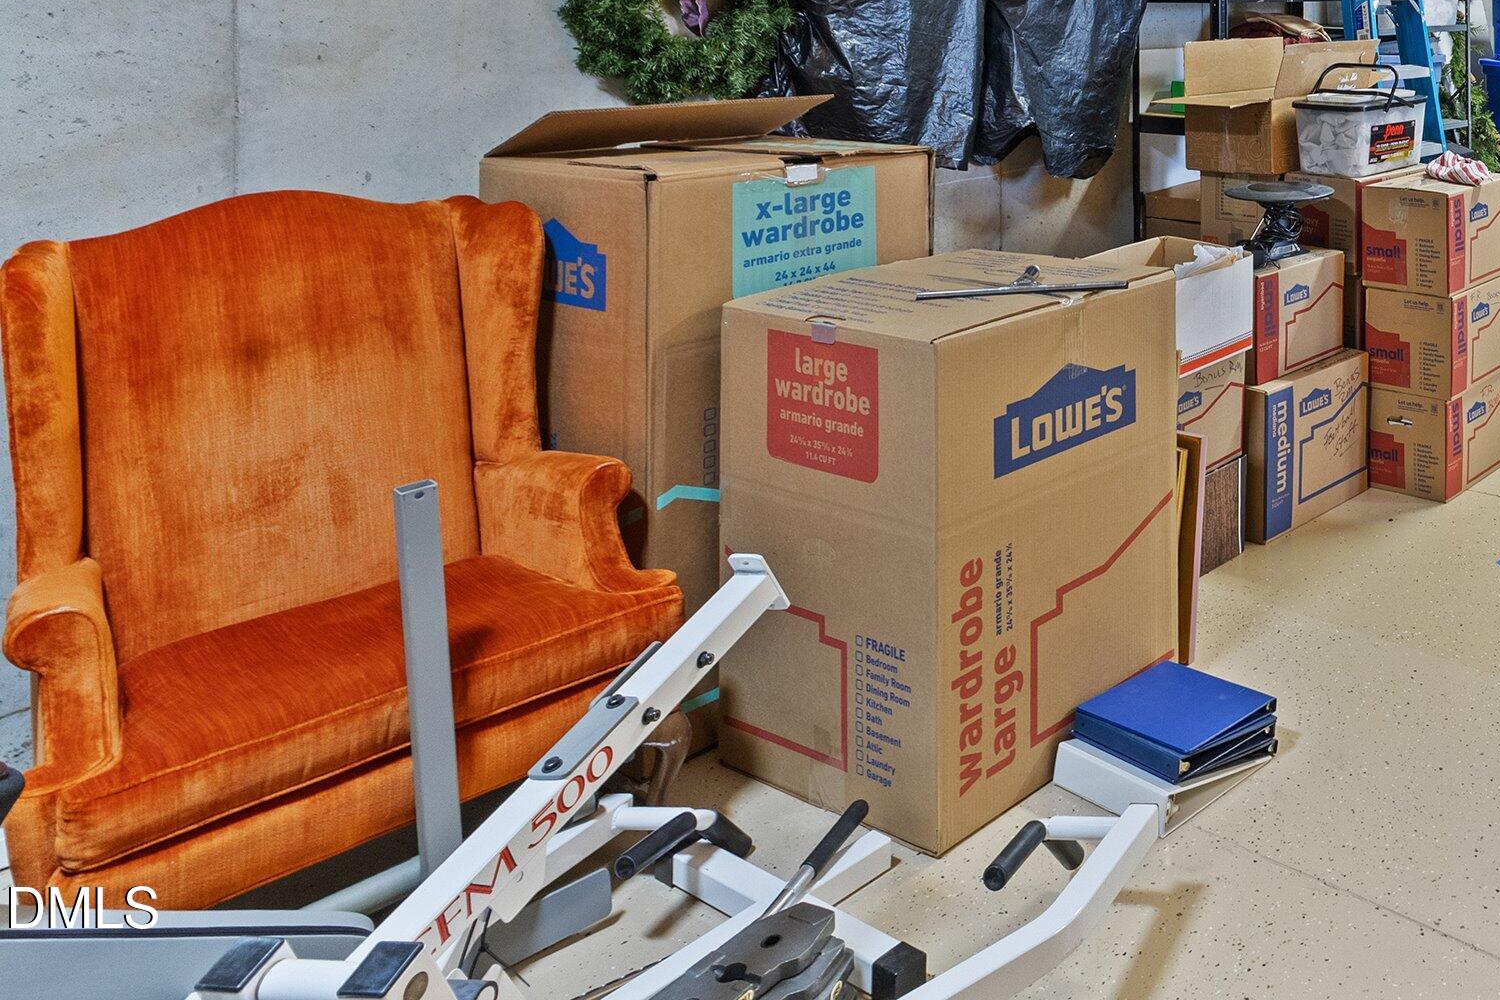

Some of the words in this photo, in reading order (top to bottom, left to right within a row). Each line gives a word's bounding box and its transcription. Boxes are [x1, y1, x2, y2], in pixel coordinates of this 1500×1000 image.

[756, 190, 851, 221] x-large
[741, 210, 864, 247] wardrobe
[1454, 200, 1464, 252] small
[743, 251, 790, 268] armario
[792, 245, 822, 259] extra
[825, 237, 862, 255] grande
[1366, 245, 1400, 259] small
[775, 270, 788, 281] 24
[800, 266, 813, 277] 24
[823, 261, 836, 271] 44
[1286, 289, 1308, 304] LOWE'S
[1458, 301, 1467, 354] small
[795, 347, 848, 386] large
[1369, 347, 1404, 362] small
[774, 378, 871, 416] wardrobe
[1178, 396, 1200, 413] OWE'S
[1302, 394, 1329, 414] LOWE'S
[779, 408, 822, 428] armario
[825, 418, 864, 438] grande
[1011, 384, 1124, 461] LOWE'S
[1469, 406, 1486, 420] LOWE'S
[1453, 403, 1462, 457] small
[819, 454, 827, 463] CU
[828, 456, 836, 465] FT
[1276, 400, 1292, 494] medium
[1370, 448, 1398, 462] mall
[994, 549, 1004, 589] grande
[994, 591, 1003, 637] armario
[866, 637, 906, 662] FRAGILE
[866, 655, 898, 674] Bedroom
[951, 556, 984, 798] wardrobe
[866, 669, 890, 687] Family
[891, 678, 912, 694] Room
[866, 683, 889, 701] Dining
[890, 693, 911, 708] Room
[866, 698, 893, 716] Kitchen
[866, 712, 883, 726] Bath
[985, 643, 1024, 780] large
[866, 726, 902, 748] Basement
[866, 741, 883, 755] Attic
[866, 754, 896, 776] Laundry
[866, 769, 892, 788] Garage
[527, 745, 614, 850] 500
